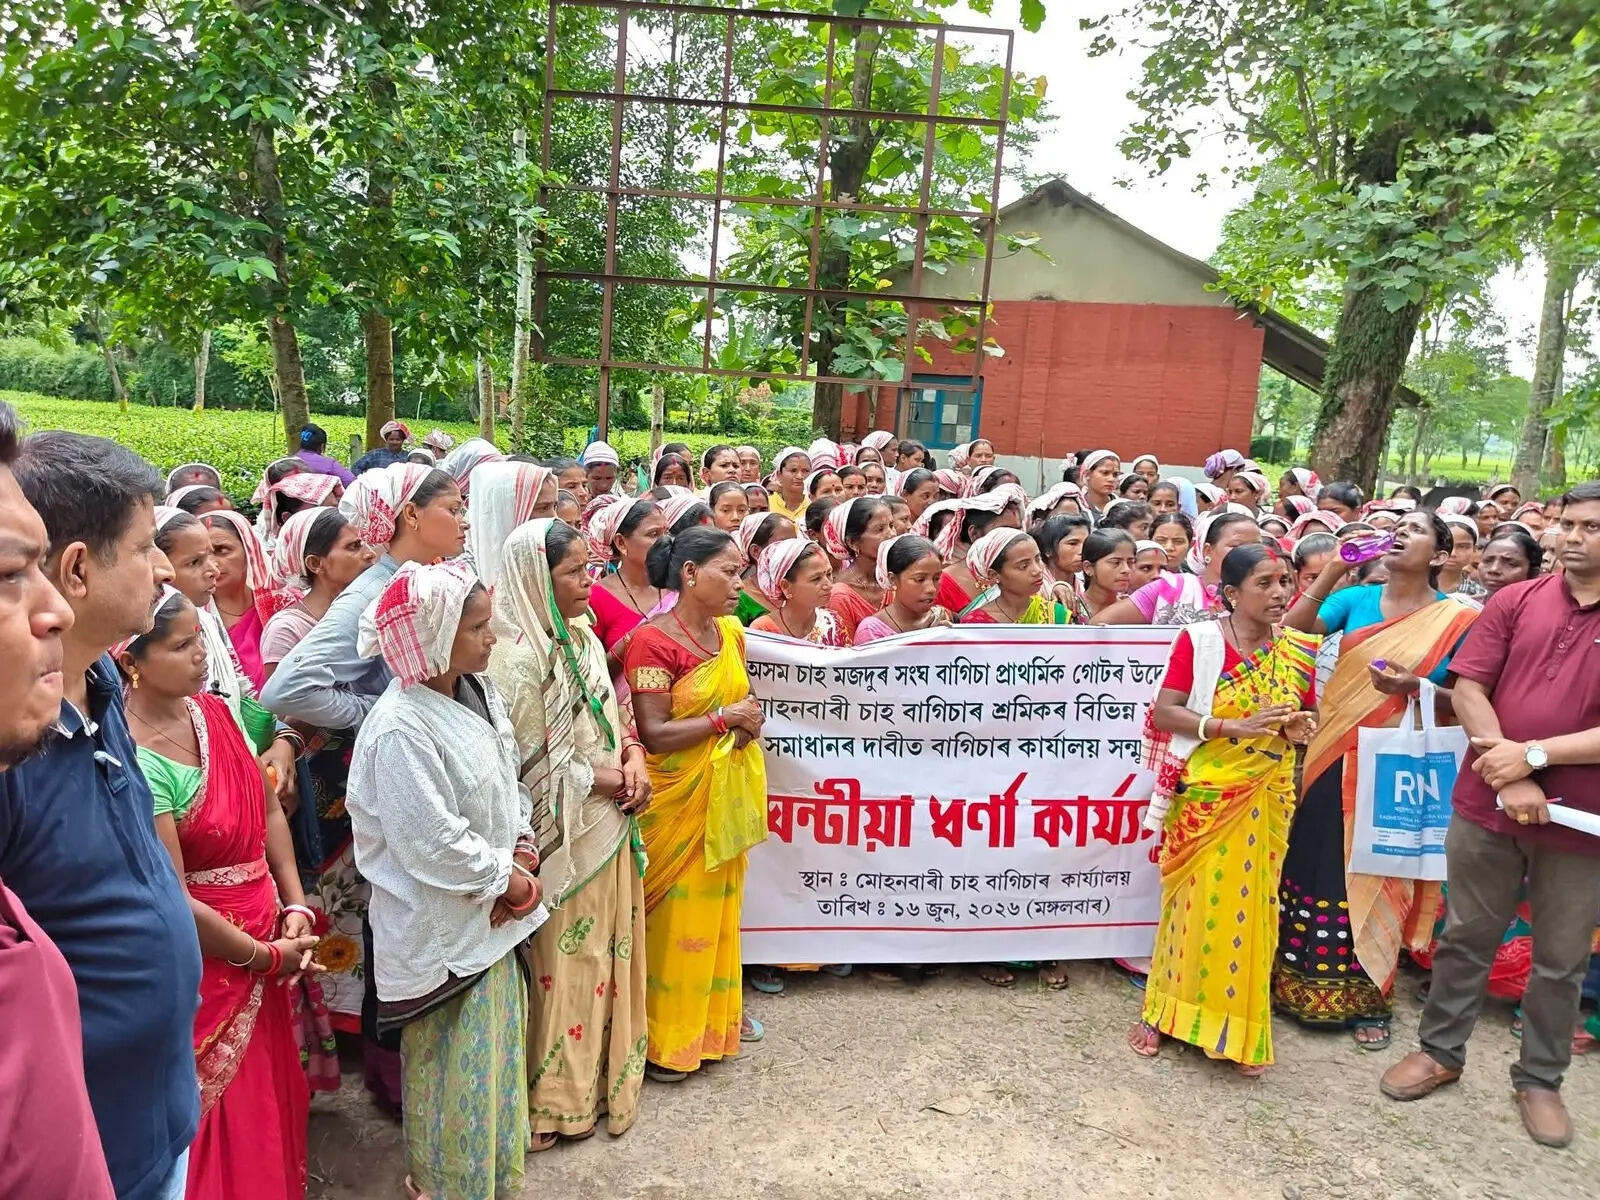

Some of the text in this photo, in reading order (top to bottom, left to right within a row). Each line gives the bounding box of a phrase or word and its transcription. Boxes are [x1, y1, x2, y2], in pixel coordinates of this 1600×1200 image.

[747, 660, 789, 683] অসম
[796, 664, 827, 688] চাহ
[833, 666, 889, 692] মজদুৰ
[895, 665, 929, 686] সংঘ
[936, 656, 990, 686] বাগিচা
[1072, 658, 1126, 686] গোটৰ
[858, 702, 895, 725] চাহ
[903, 695, 983, 723] বাগিচাৰ
[992, 695, 1067, 723] শ্ৰমিকৰ
[1074, 693, 1138, 722] বিভিন্ন
[764, 733, 855, 758] সমাধানৰ
[862, 731, 924, 758] দাবীত
[931, 731, 1011, 758] বাগিচাৰ
[799, 870, 833, 891] স্থান
[856, 869, 944, 891] মোহনবাৰী
[950, 873, 980, 892] চাহ
[985, 869, 1051, 891] বাগিচাৰ
[817, 894, 871, 917] তাৰিখ
[895, 902, 920, 917] ১৬
[926, 903, 960, 922] জুন,
[968, 902, 1020, 918] ২০২৬
[1026, 896, 1111, 919] (মঙ্গলবাৰ)
